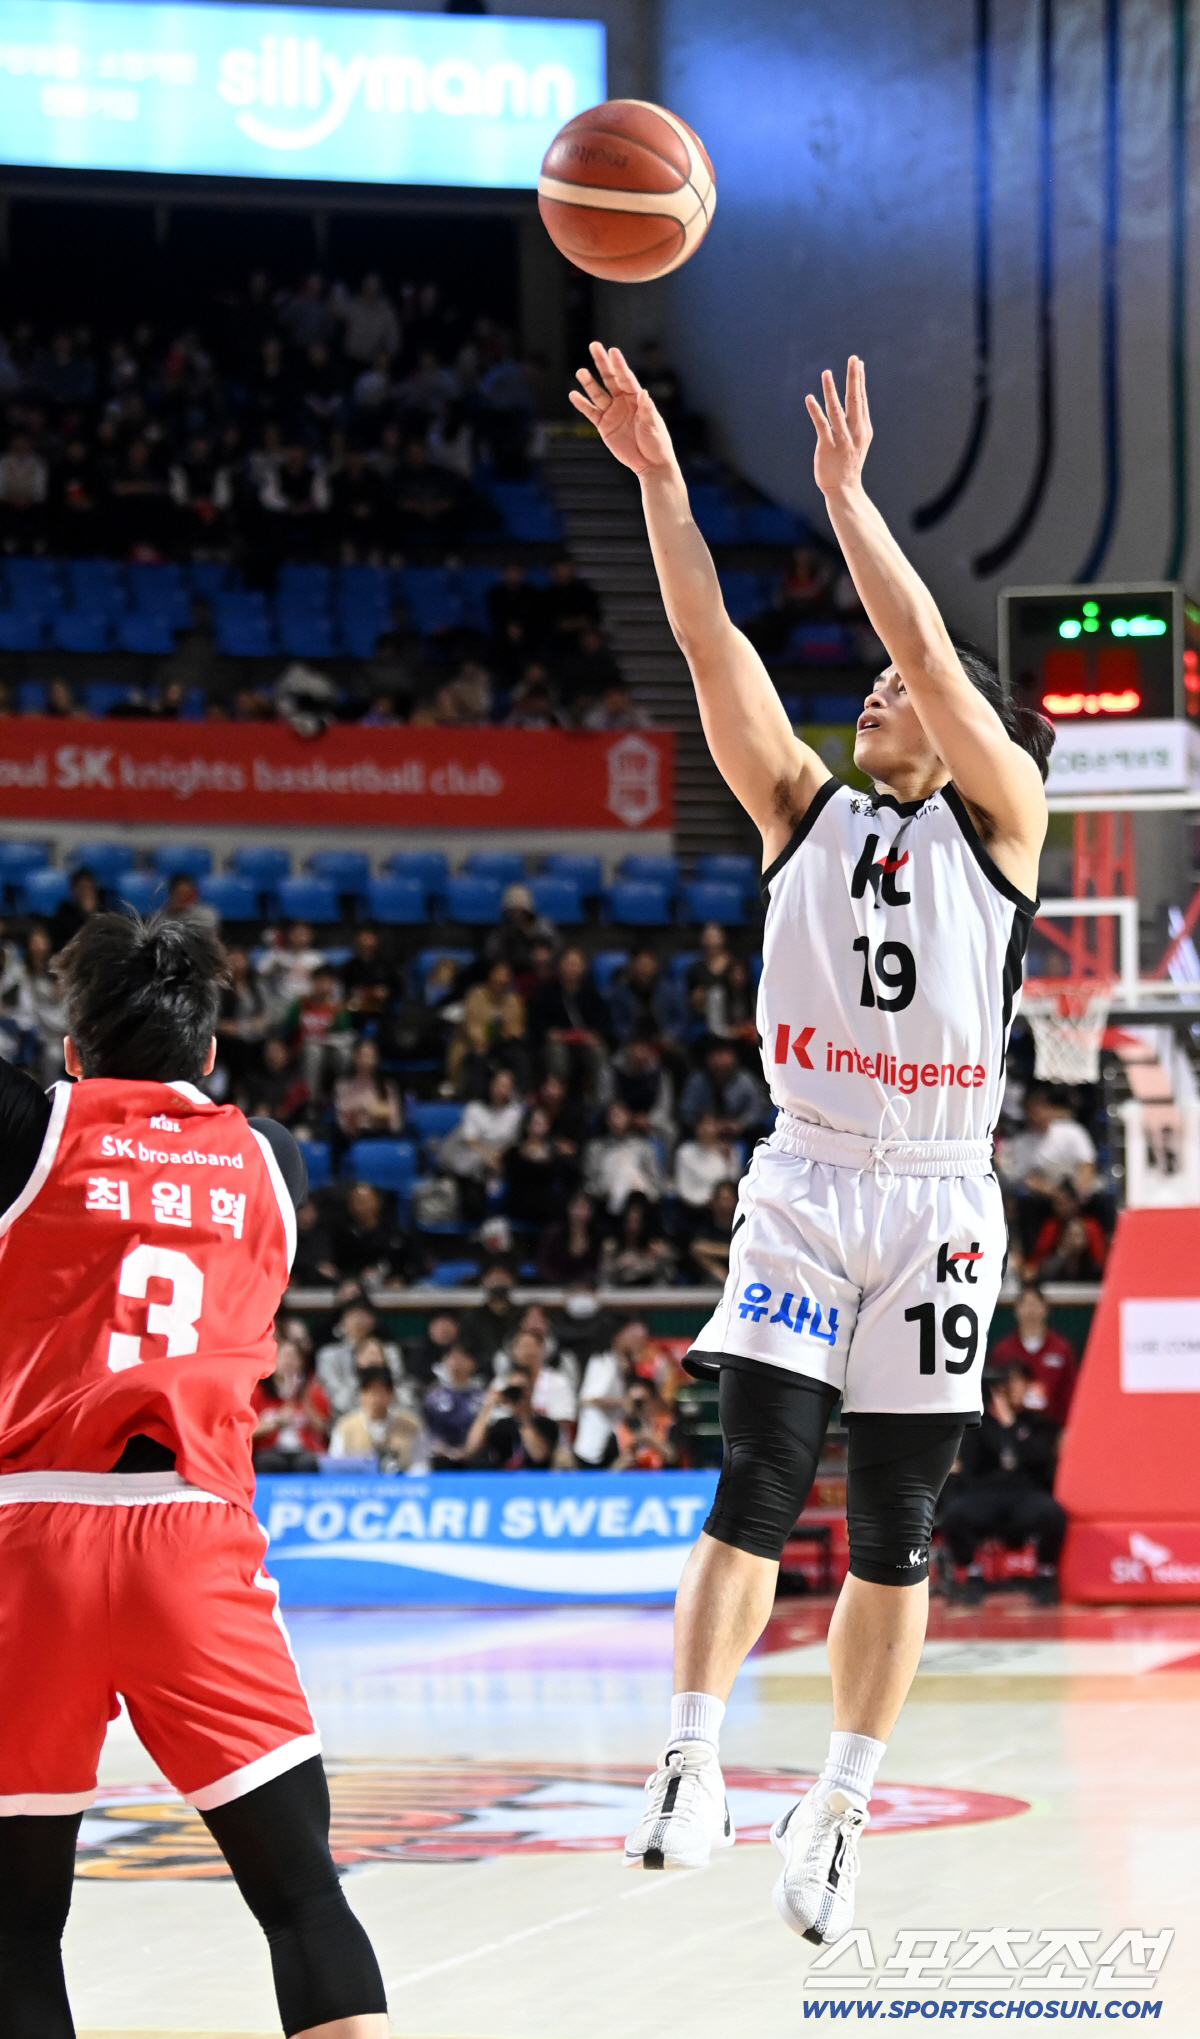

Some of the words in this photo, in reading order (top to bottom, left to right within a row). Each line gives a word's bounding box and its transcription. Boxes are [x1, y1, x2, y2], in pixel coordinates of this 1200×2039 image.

[216, 35, 577, 149] sillymann
[55, 745, 114, 789] SK
[119, 752, 246, 799] knights
[252, 756, 424, 794] basketball
[430, 758, 504, 796] club
[853, 936, 917, 1013] 19
[774, 1023, 816, 1070] K
[826, 1041, 986, 1094] intelligence
[101, 1135, 136, 1158] SK
[138, 1141, 244, 1169] broadband
[936, 1241, 985, 1285] kt
[107, 1243, 204, 1374] 3
[905, 1302, 979, 1376] 19
[269, 1498, 491, 1540] POCARI
[501, 1496, 704, 1538] SWEAT
